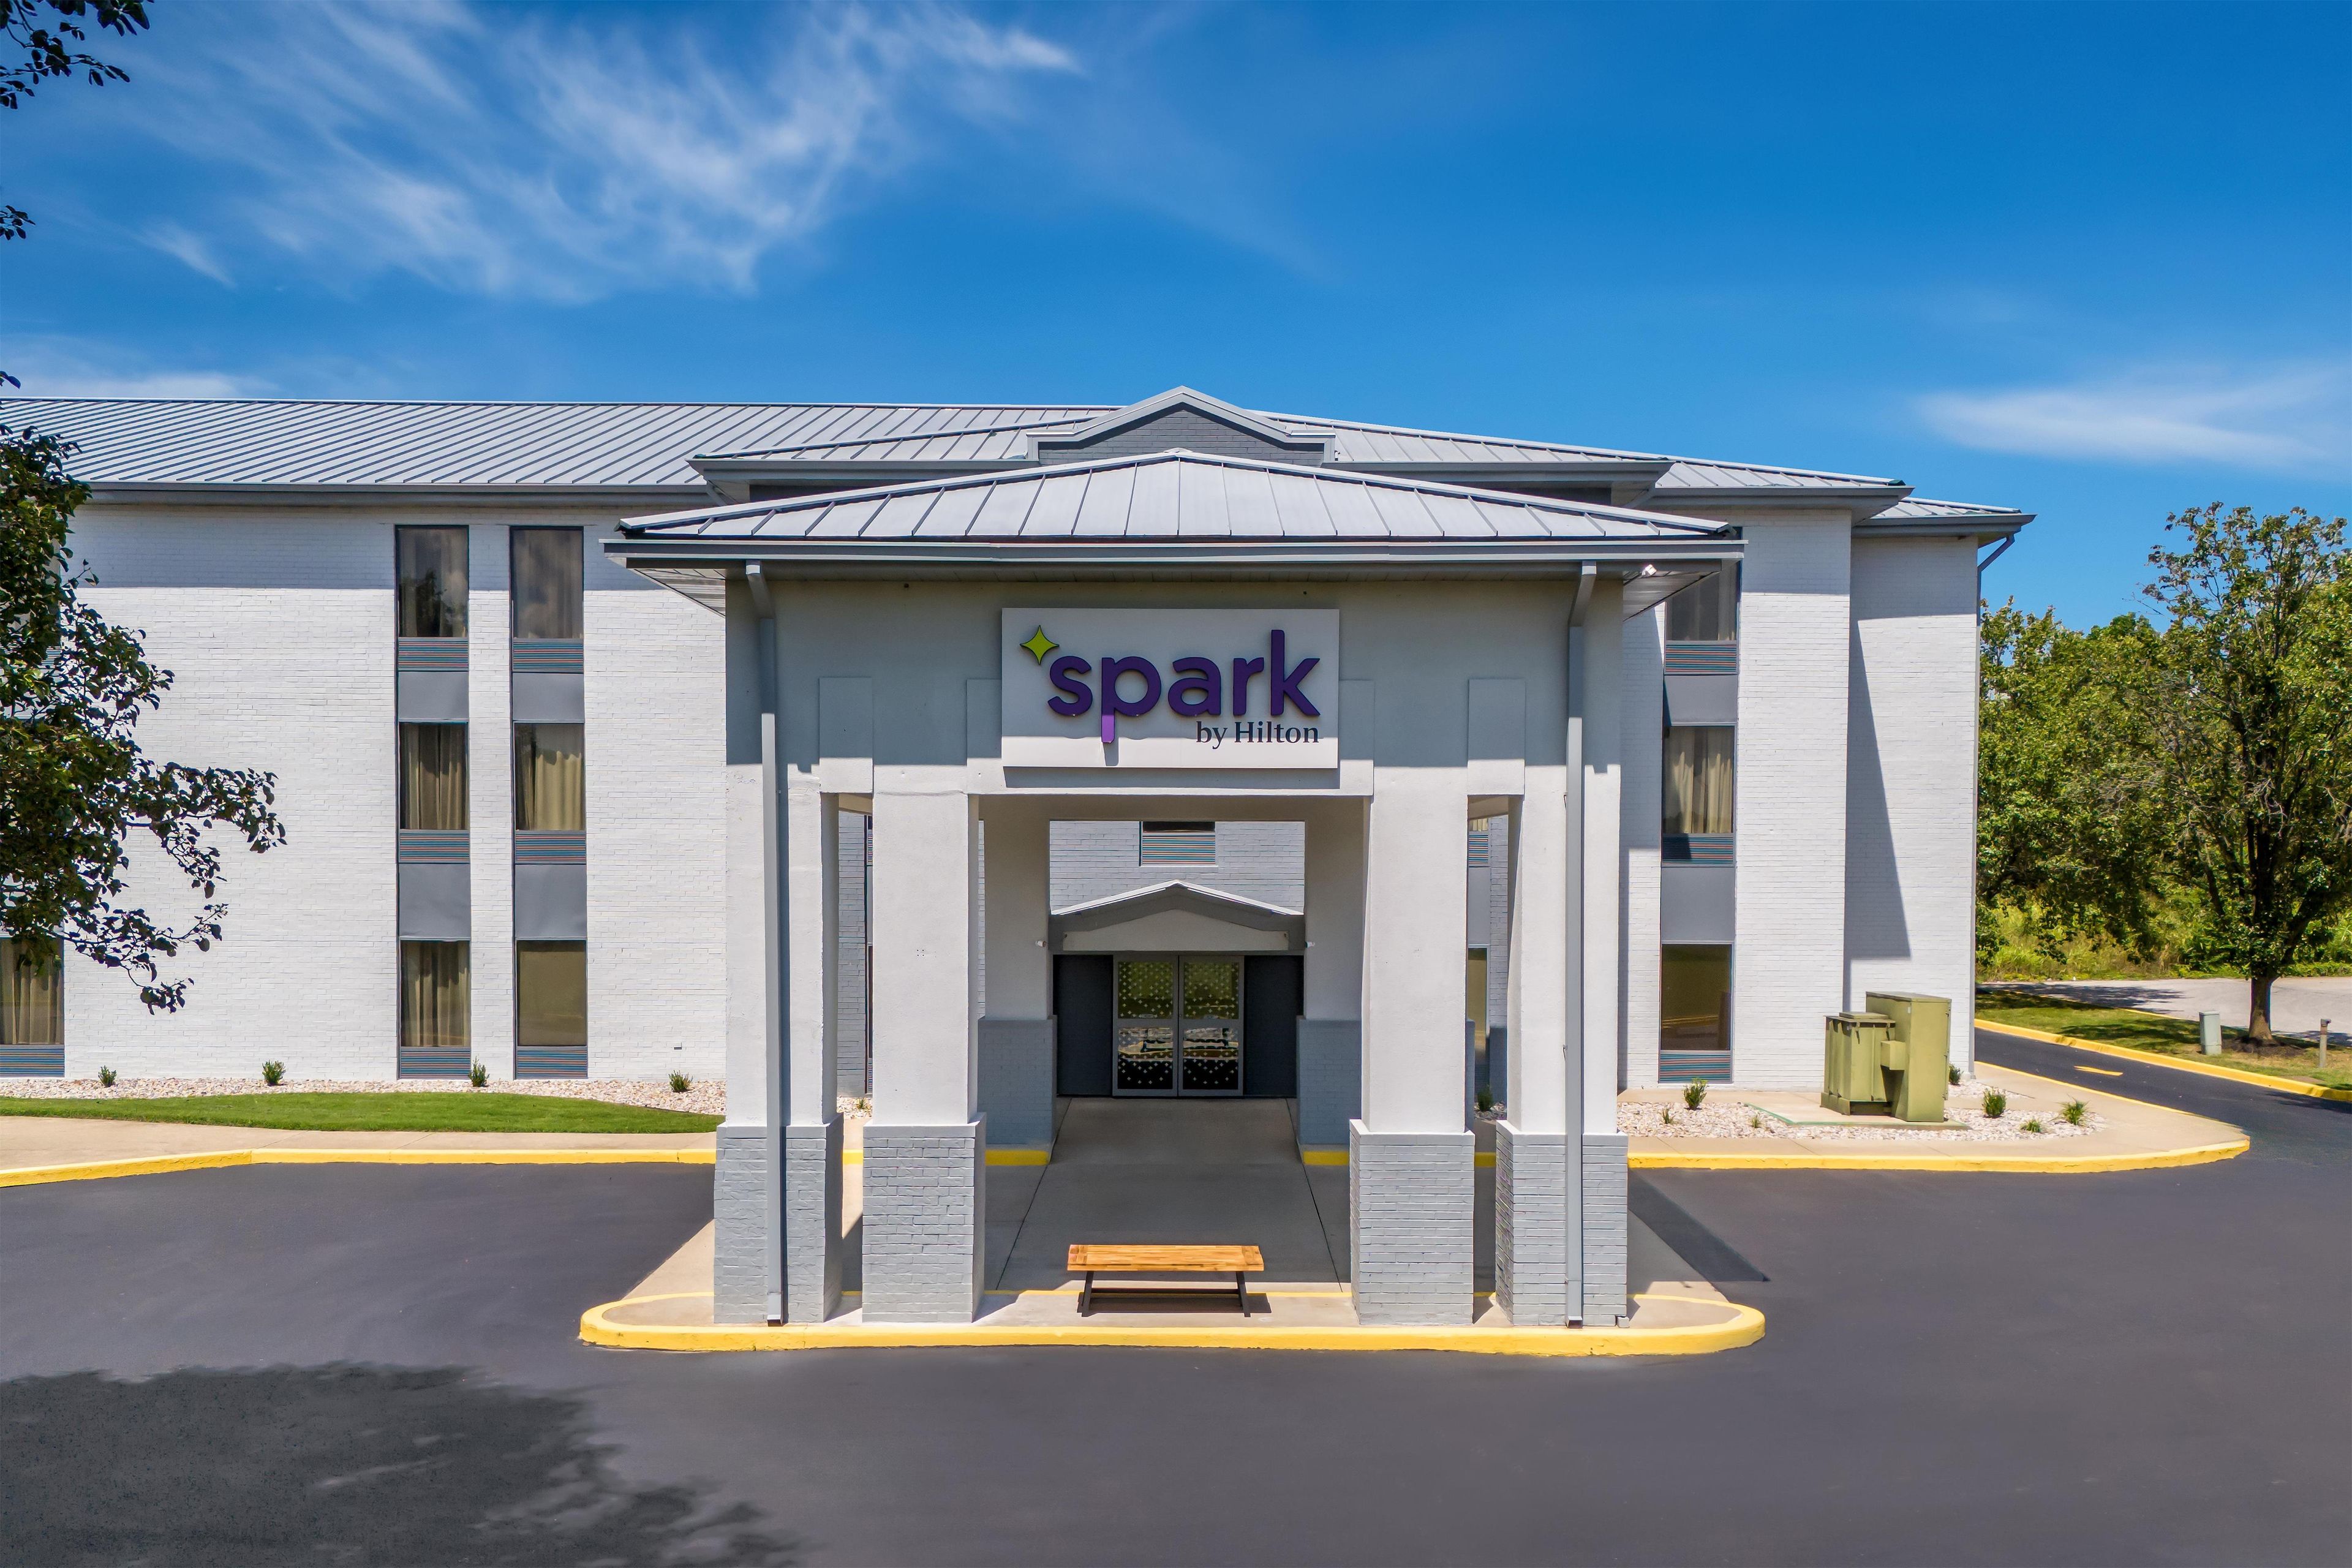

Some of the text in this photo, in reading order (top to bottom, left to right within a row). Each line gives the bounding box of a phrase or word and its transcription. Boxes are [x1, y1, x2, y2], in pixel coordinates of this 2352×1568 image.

[1047, 630, 1321, 744] spark
[1196, 721, 1319, 750] by Hilton
